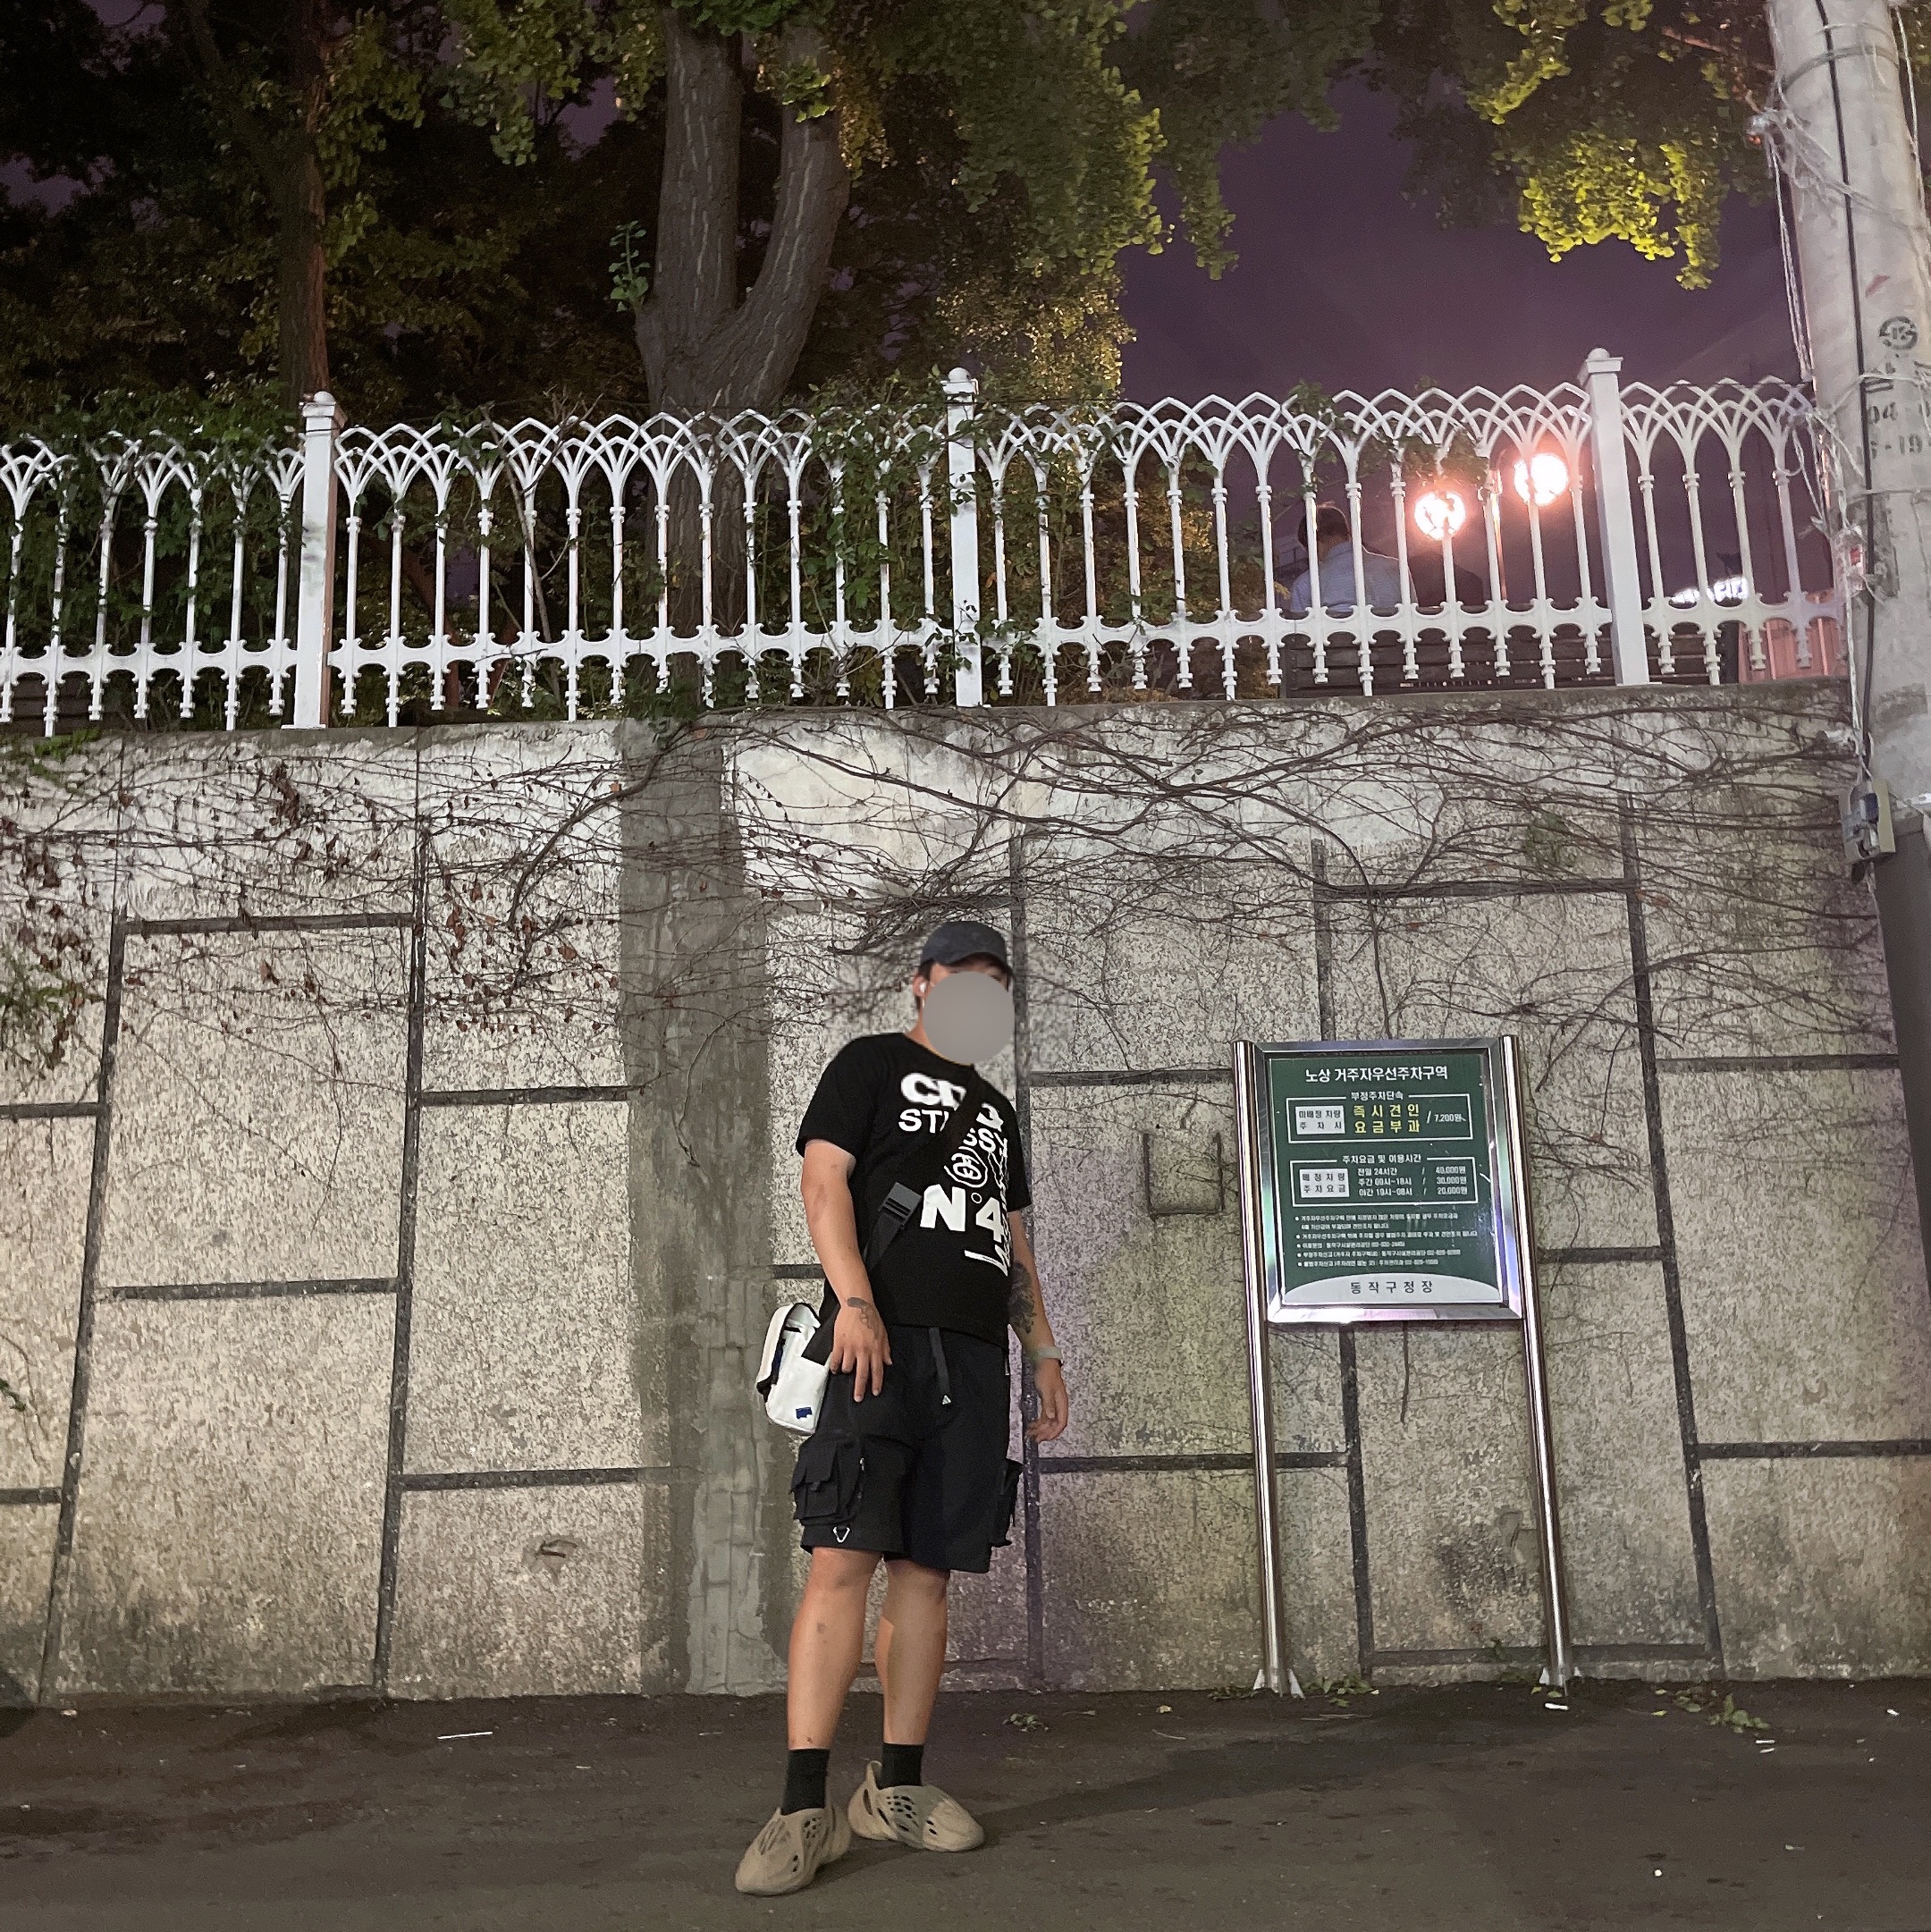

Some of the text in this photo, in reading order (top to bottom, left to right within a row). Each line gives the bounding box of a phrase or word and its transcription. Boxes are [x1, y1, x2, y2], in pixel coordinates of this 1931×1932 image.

[1305, 1066, 1448, 1083] 노상 거주자우선주차구역
[1351, 1091, 1404, 1101] 부정주차단속
[1342, 1155, 1375, 1164] 주차요금
[1388, 1153, 1421, 1164] 이용시간
[1373, 1167, 1398, 1177] 24시간
